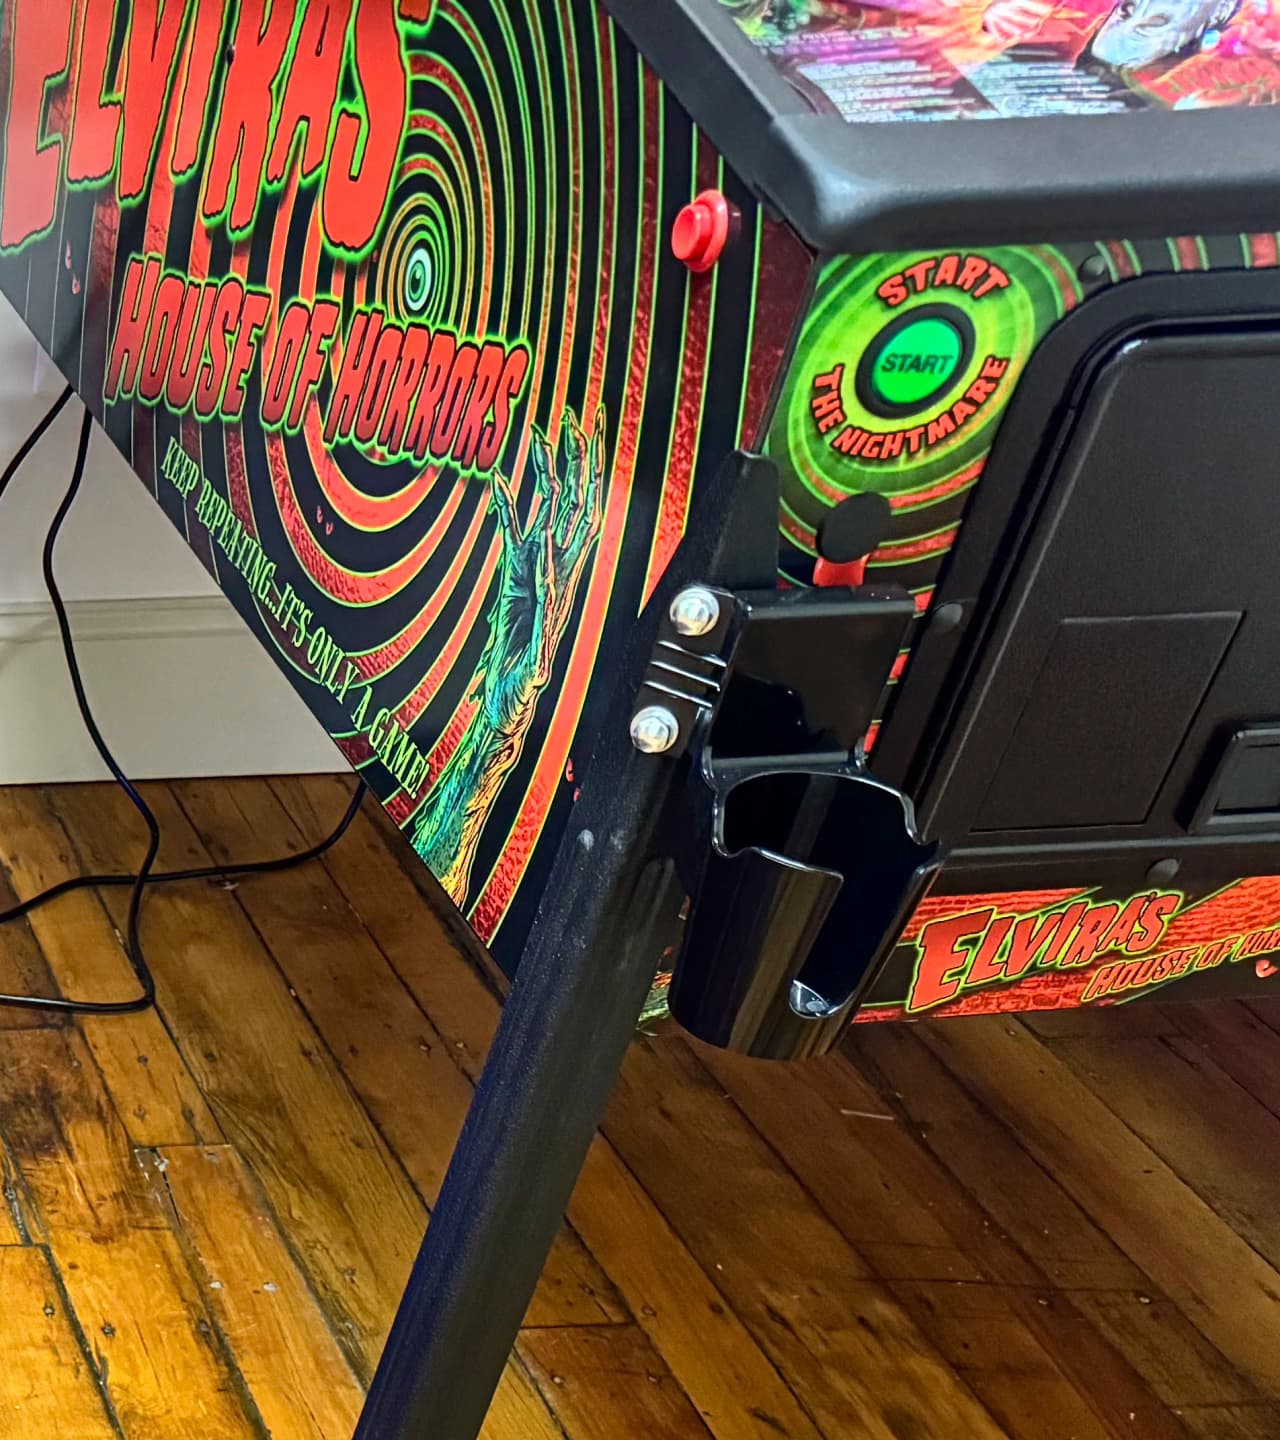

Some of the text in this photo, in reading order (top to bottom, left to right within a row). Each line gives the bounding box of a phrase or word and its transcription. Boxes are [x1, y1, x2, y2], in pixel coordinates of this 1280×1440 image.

[878, 255, 1010, 306] START
[104, 256, 530, 473] HOUSE OF HORRORS
[881, 353, 953, 374] START
[812, 355, 1010, 460] THE NIGHTMARE
[161, 436, 201, 500] KEEP
[307, 626, 360, 705] ONLY
[351, 685, 374, 732] A
[368, 707, 431, 800] GAME!
[1082, 946, 1200, 1000] HOUSE
[1197, 935, 1239, 969] OF
